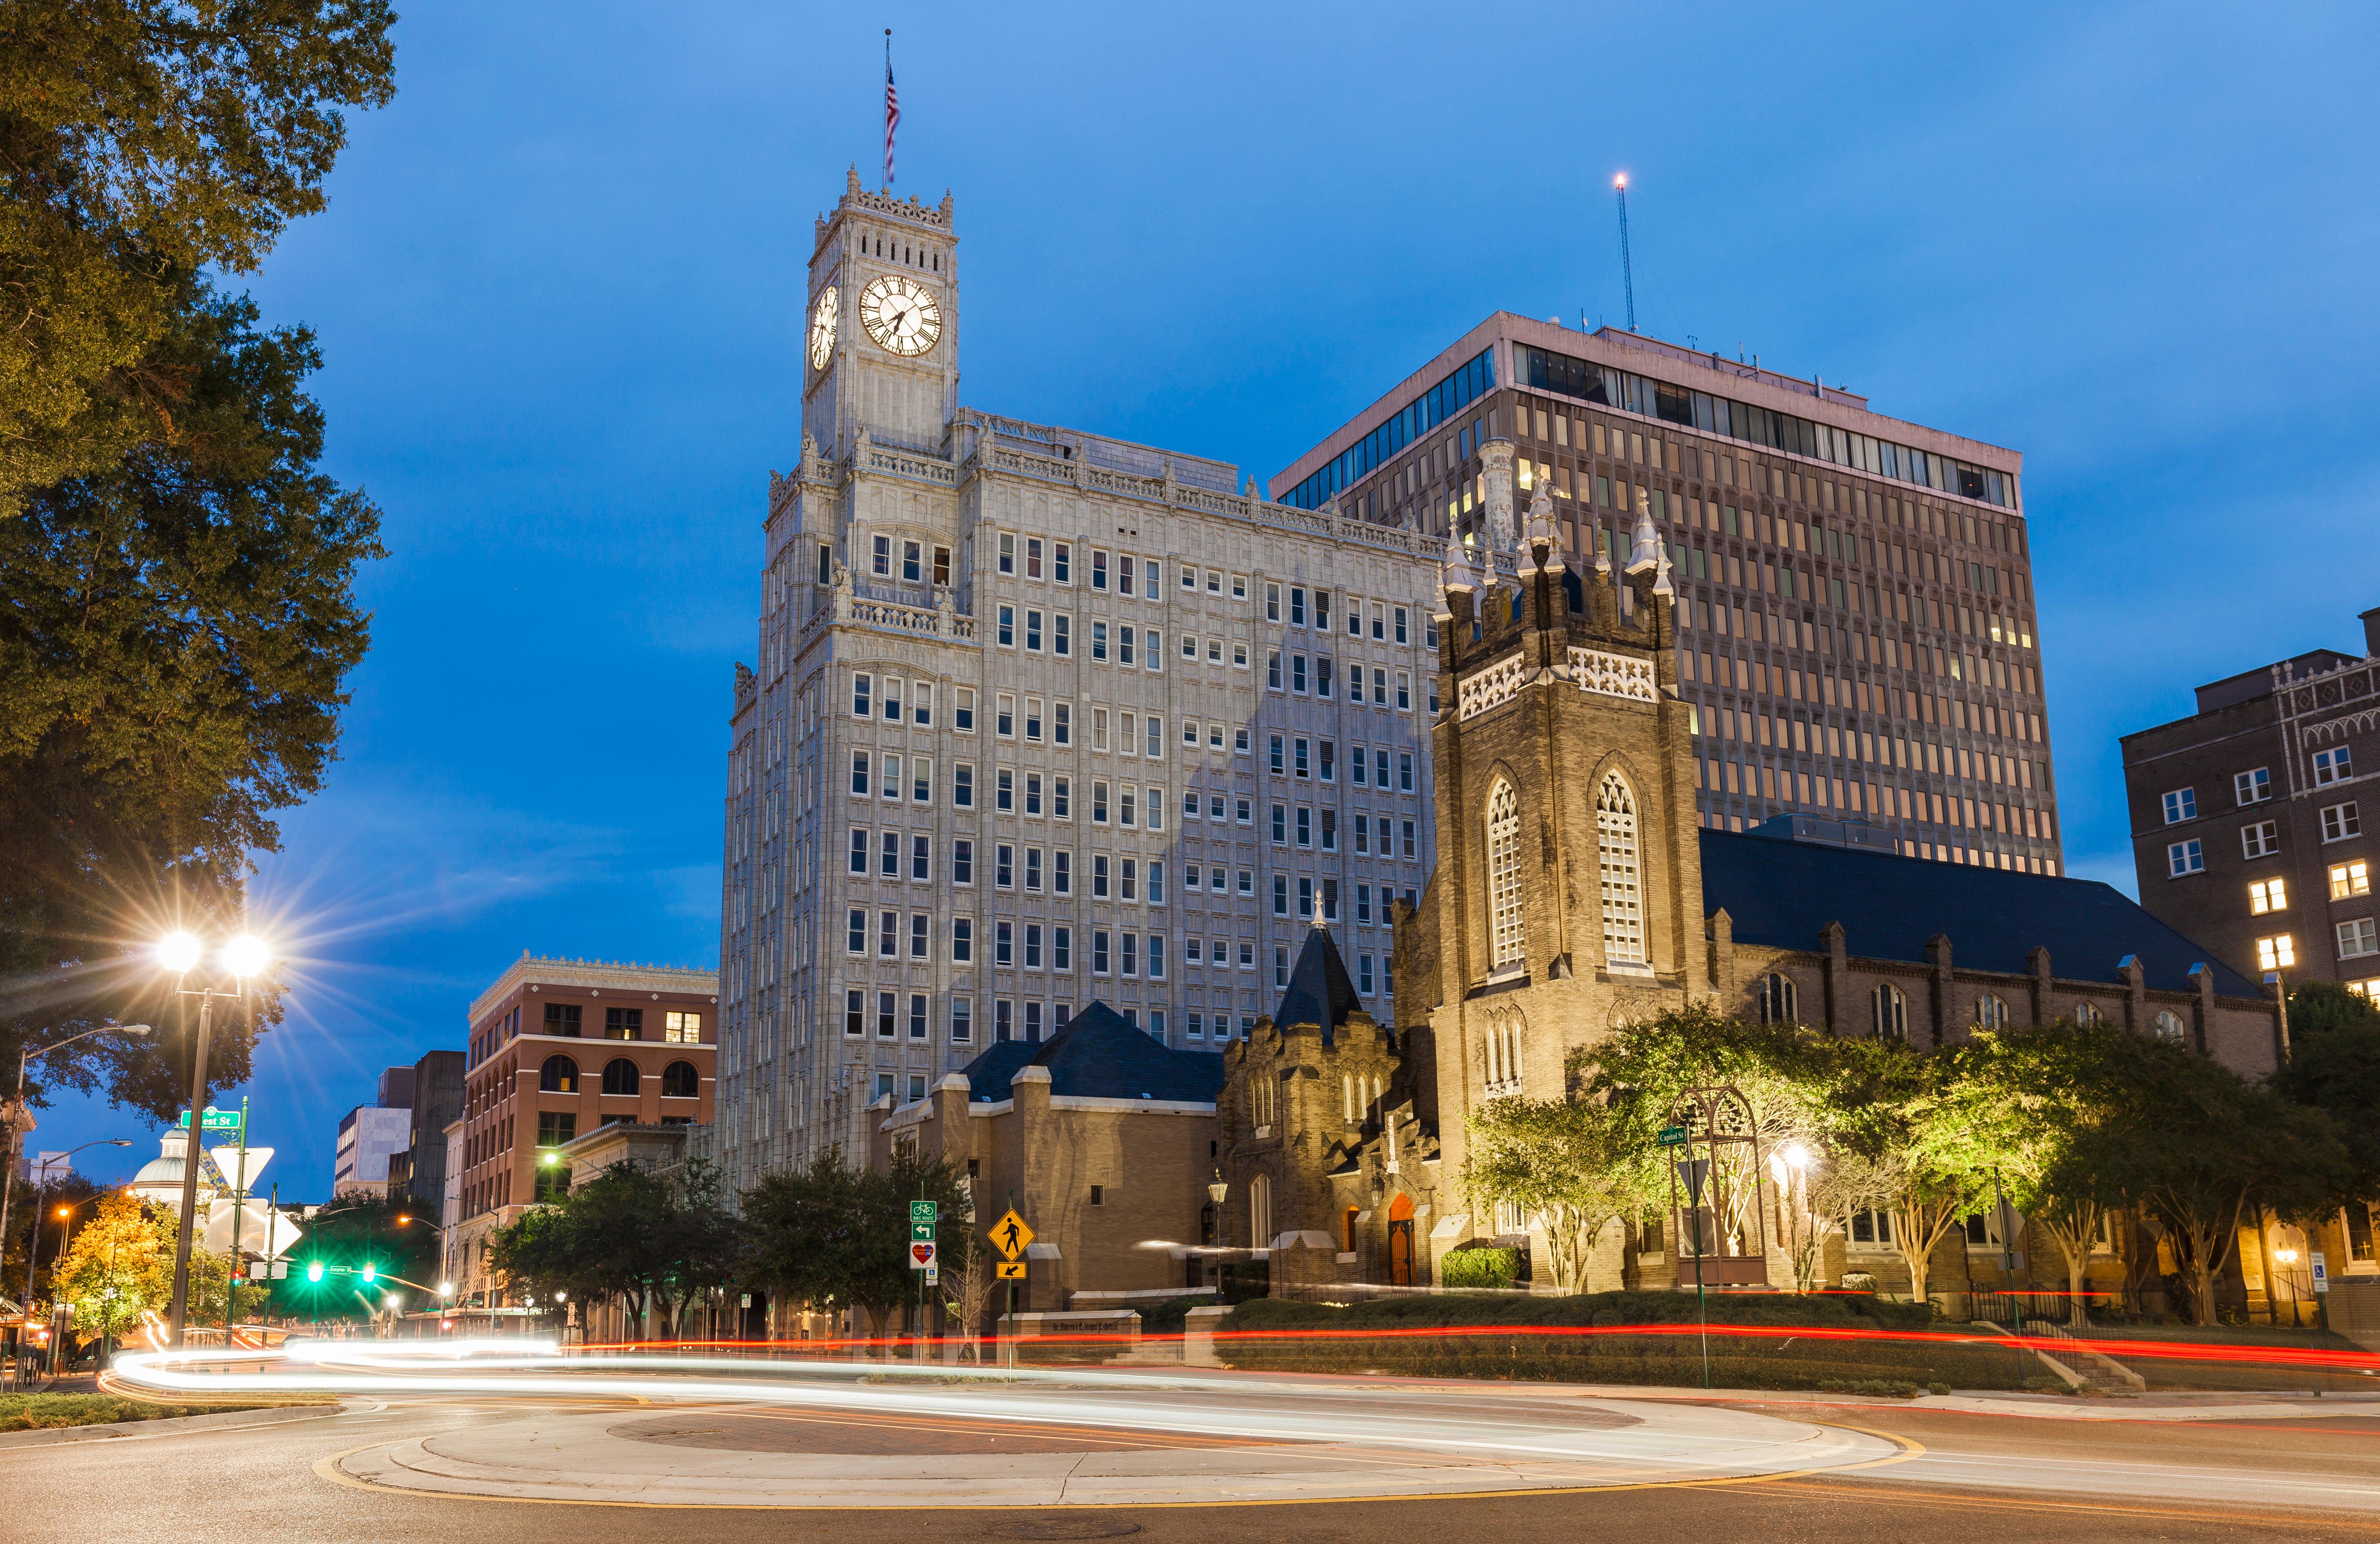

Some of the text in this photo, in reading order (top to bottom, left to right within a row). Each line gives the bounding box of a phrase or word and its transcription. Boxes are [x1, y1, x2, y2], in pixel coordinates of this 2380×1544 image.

[202, 1116, 230, 1125] est St
[1660, 1132, 1677, 1142] Capitol
